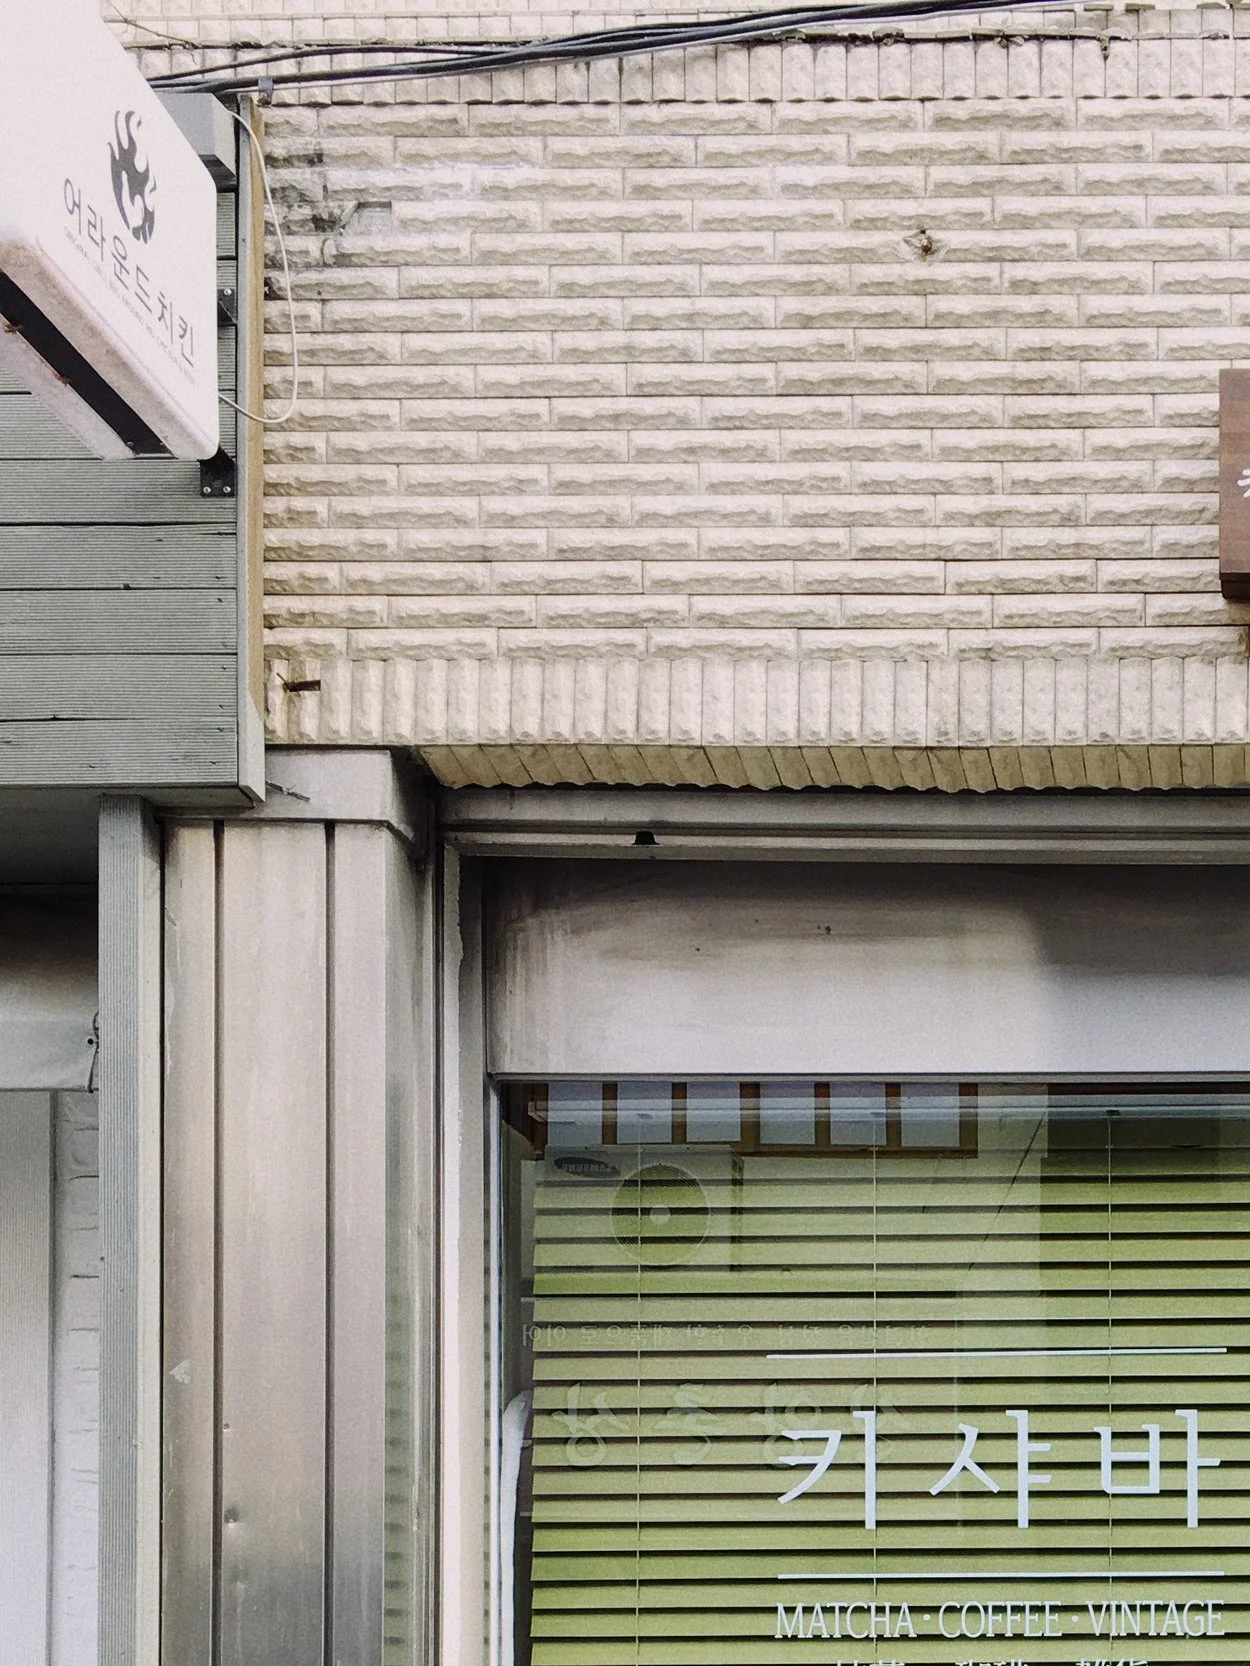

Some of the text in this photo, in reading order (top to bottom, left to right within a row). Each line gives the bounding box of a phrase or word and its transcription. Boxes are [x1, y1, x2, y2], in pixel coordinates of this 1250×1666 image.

[63, 177, 194, 368] 어라운드치킨
[776, 1408, 1222, 1530] 키샤바
[774, 1599, 1225, 1641] MATCHA COFFEE VINTAGE
